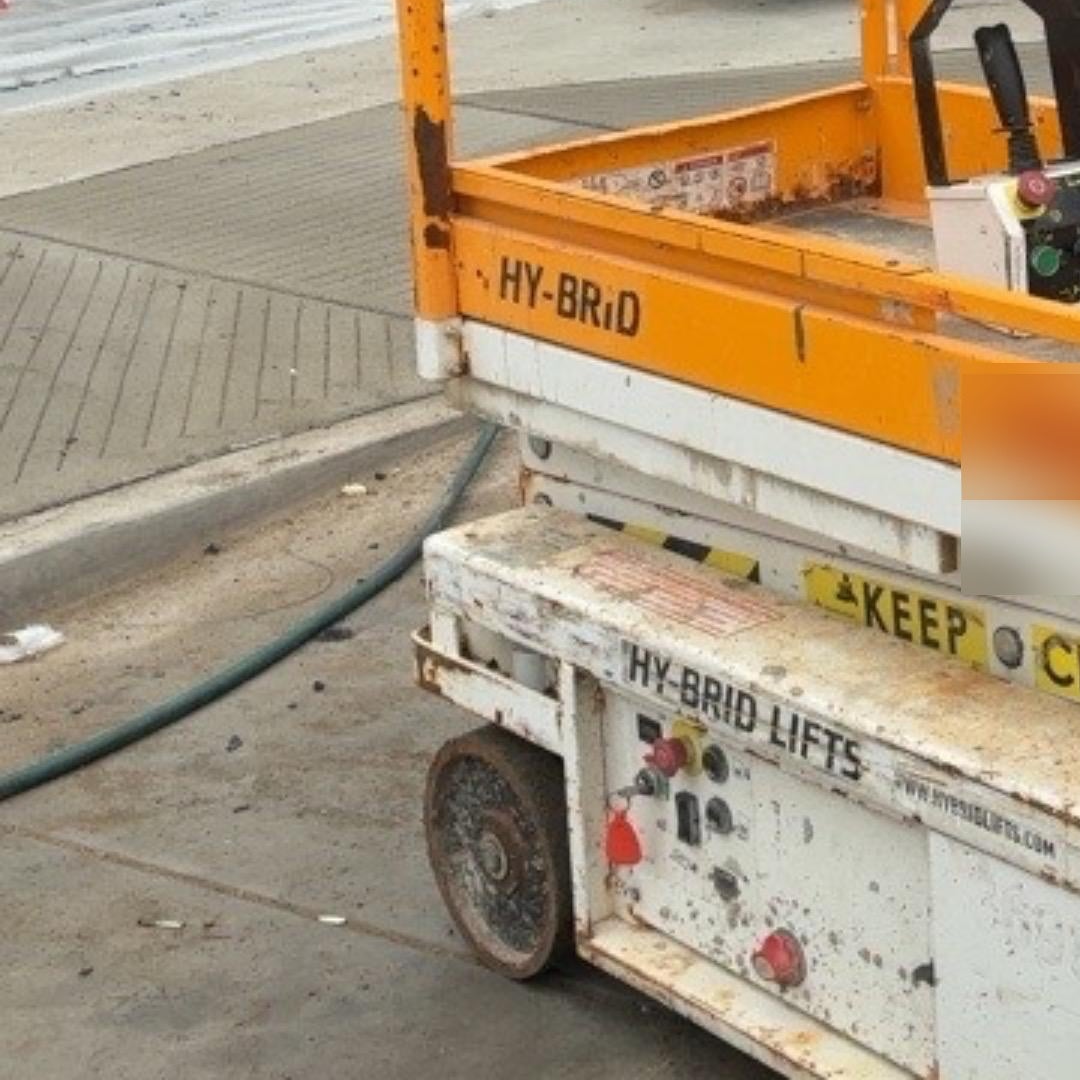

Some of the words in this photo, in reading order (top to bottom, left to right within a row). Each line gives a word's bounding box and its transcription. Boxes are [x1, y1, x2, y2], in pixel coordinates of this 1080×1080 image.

[862, 581, 968, 656] KEEP
[627, 643, 757, 733] HY-BRID
[769, 704, 863, 781] LIFTS
